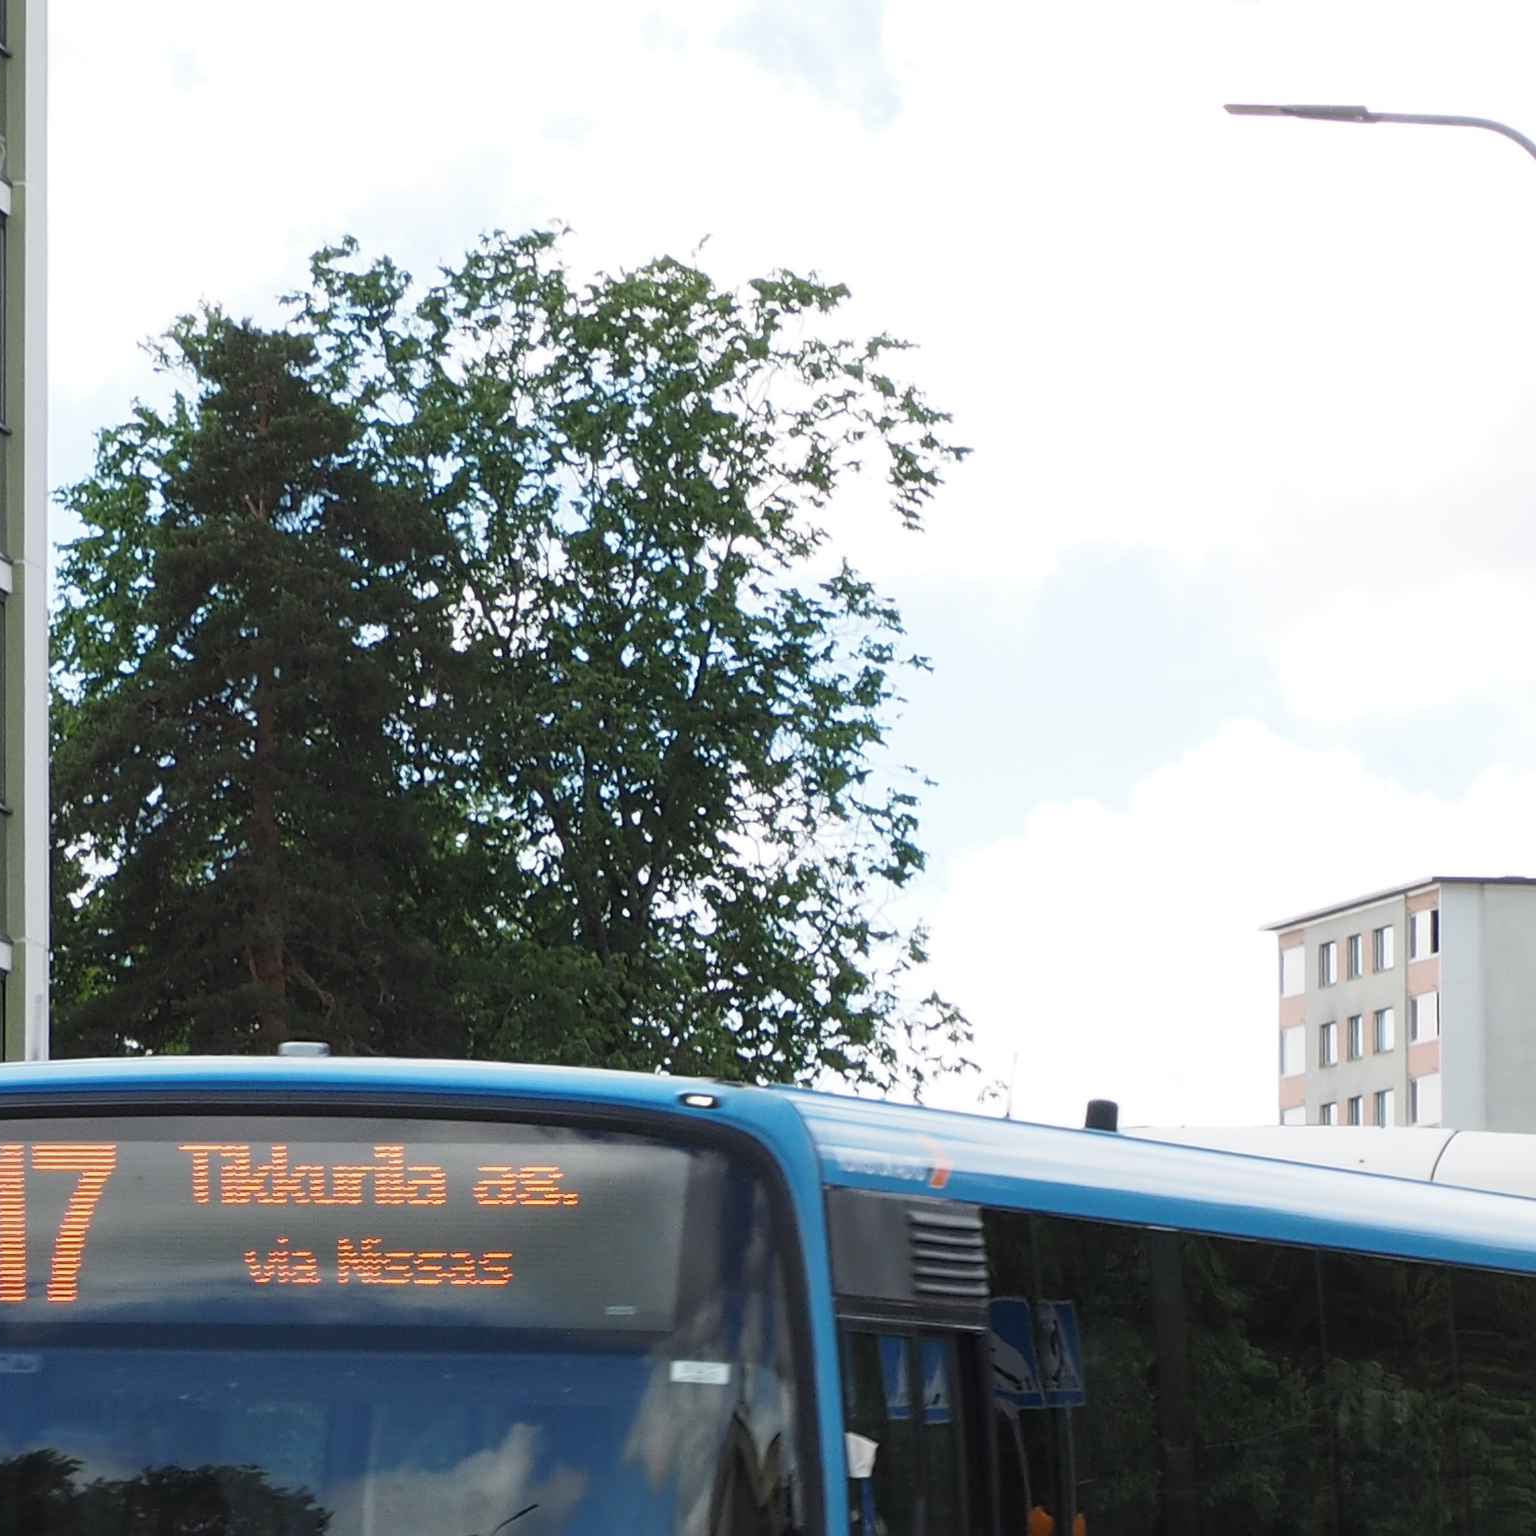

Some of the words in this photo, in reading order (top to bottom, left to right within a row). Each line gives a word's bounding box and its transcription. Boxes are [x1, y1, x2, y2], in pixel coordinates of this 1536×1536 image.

[178, 1145, 448, 1205] Tikkurila
[473, 1165, 579, 1206] as.
[245, 1238, 322, 1285] via
[337, 1238, 514, 1285] Nissas
